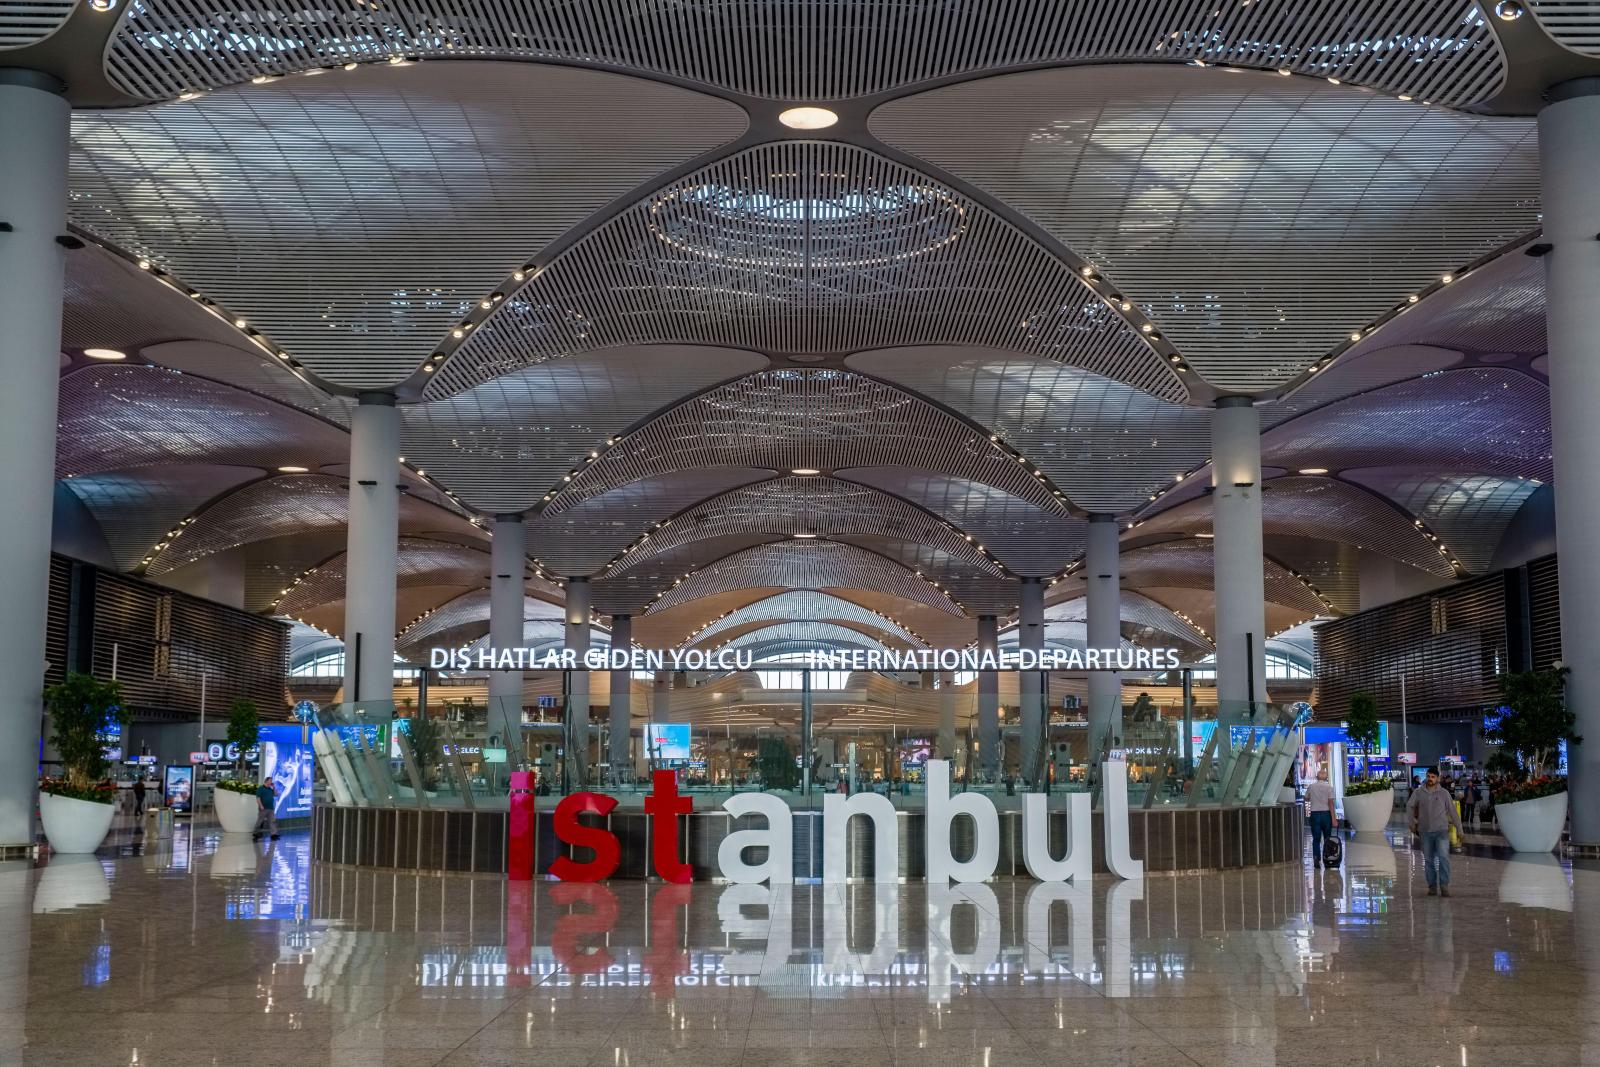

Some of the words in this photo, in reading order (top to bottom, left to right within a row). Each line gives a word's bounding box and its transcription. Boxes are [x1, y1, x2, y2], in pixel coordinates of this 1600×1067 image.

[430, 647, 472, 672] DIŞ
[479, 647, 577, 669] HATLAR
[584, 644, 663, 669] GİDEN
[670, 647, 753, 669] YOLCU
[809, 649, 1012, 670] INTERNATIONAL
[1018, 648, 1180, 669] DEPARTURES
